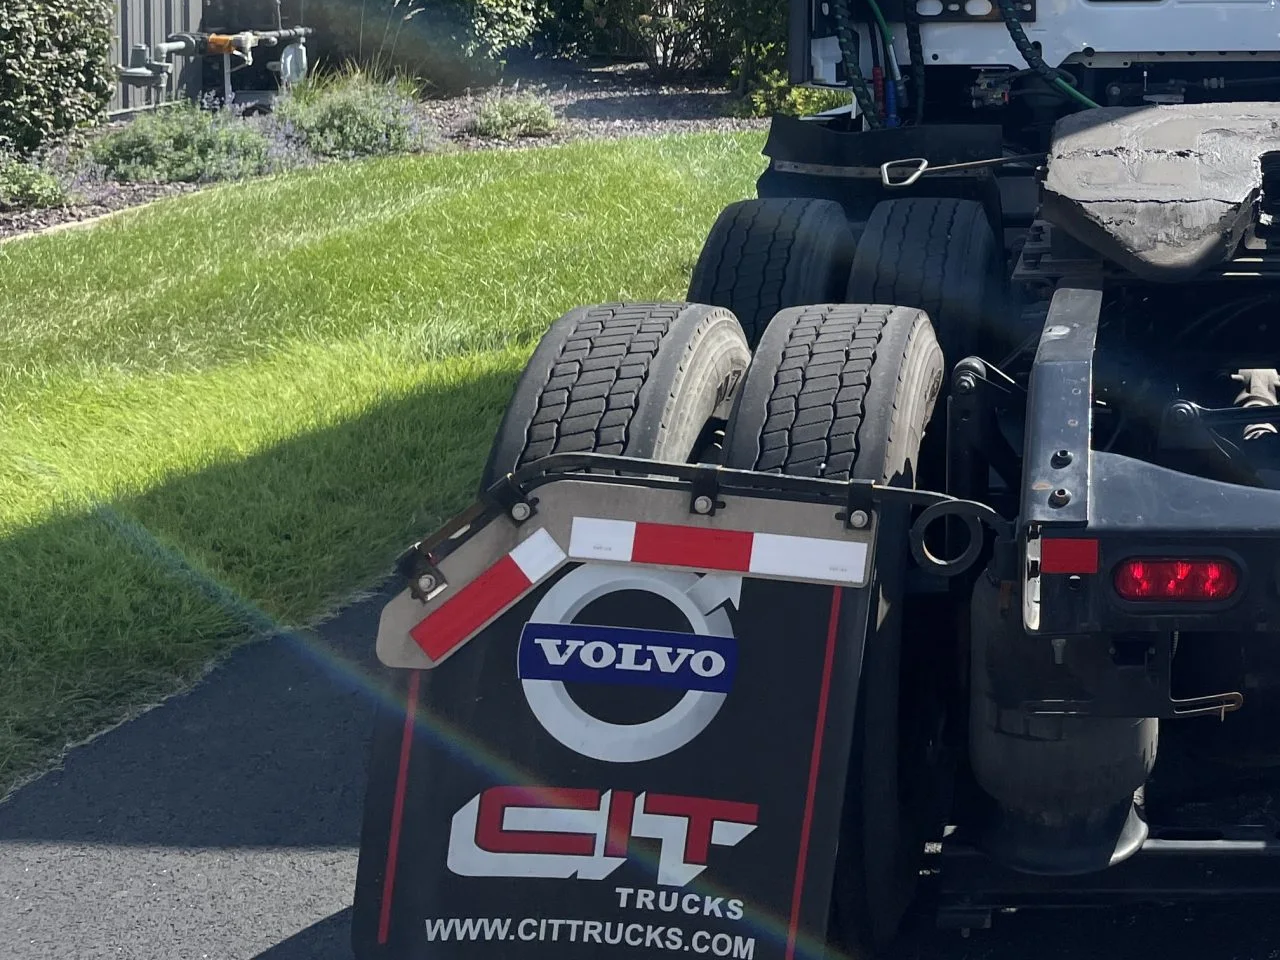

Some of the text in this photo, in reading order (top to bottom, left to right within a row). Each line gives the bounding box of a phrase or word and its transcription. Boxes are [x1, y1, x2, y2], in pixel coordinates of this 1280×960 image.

[534, 639, 726, 677] VOLVO
[448, 787, 760, 885] CIT
[615, 888, 744, 920] TRUCKS
[425, 918, 755, 960] WWW.CITTRUCKS.COM
